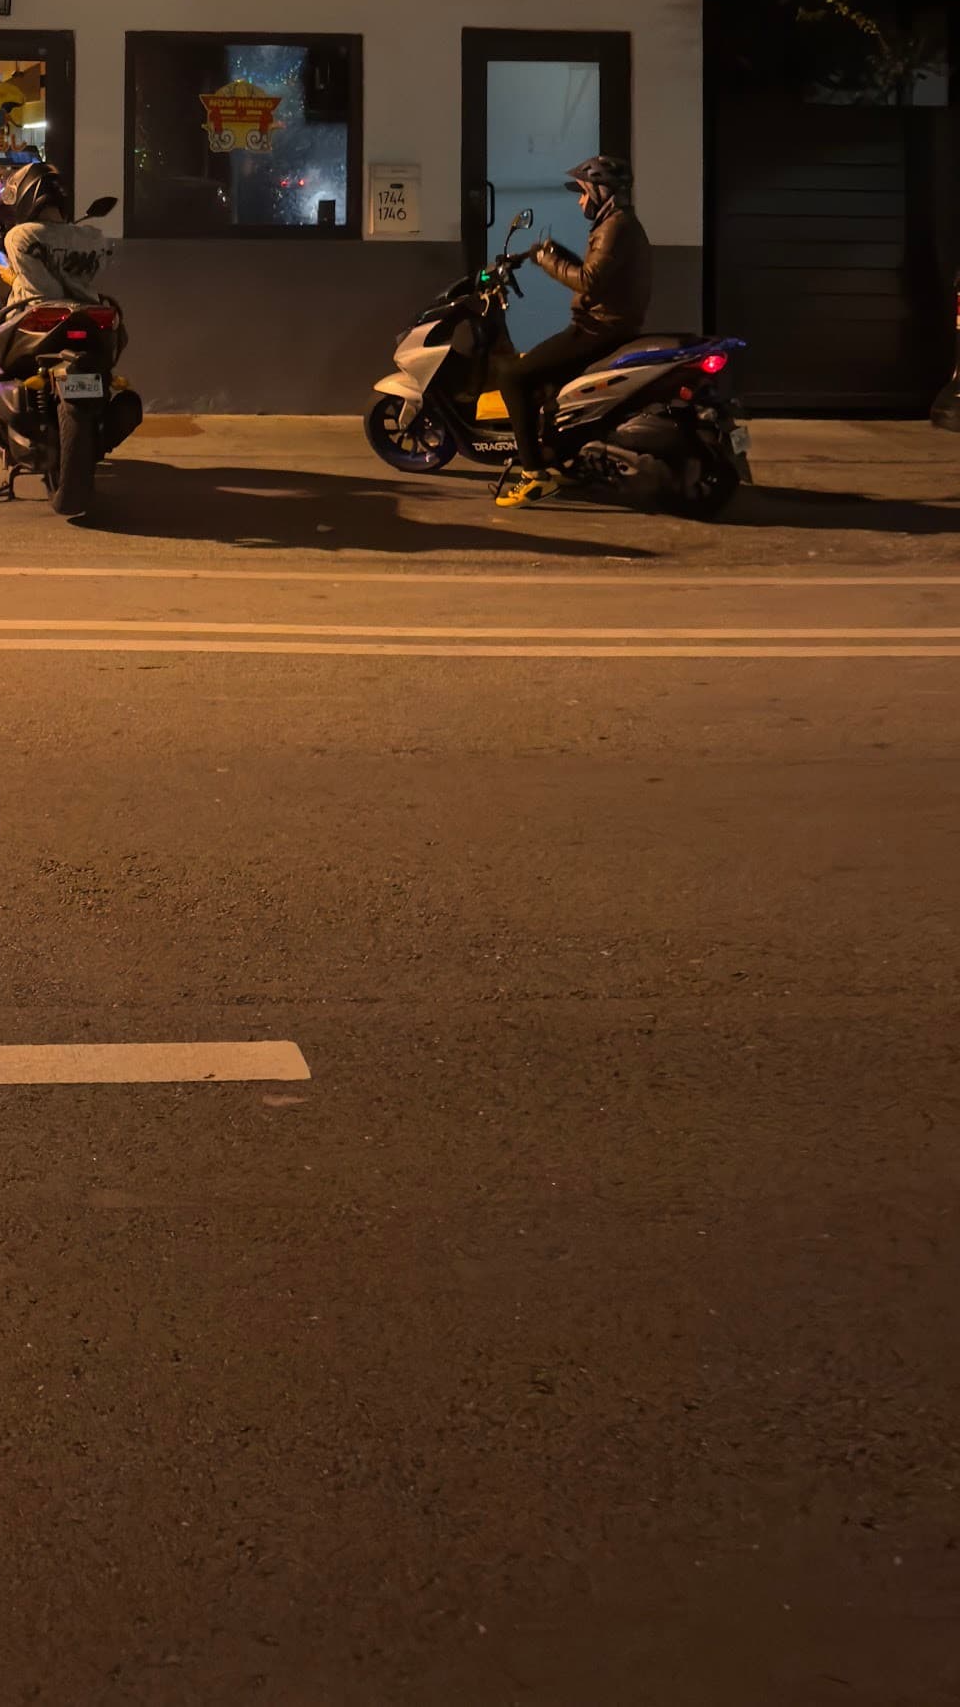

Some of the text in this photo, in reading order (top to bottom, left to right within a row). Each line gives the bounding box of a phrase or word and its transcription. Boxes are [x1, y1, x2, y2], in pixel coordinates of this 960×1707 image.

[208, 98, 274, 110] NOW HIRING
[378, 190, 406, 205] 1744
[378, 206, 407, 222] 1746
[471, 440, 519, 452] DRAGON
